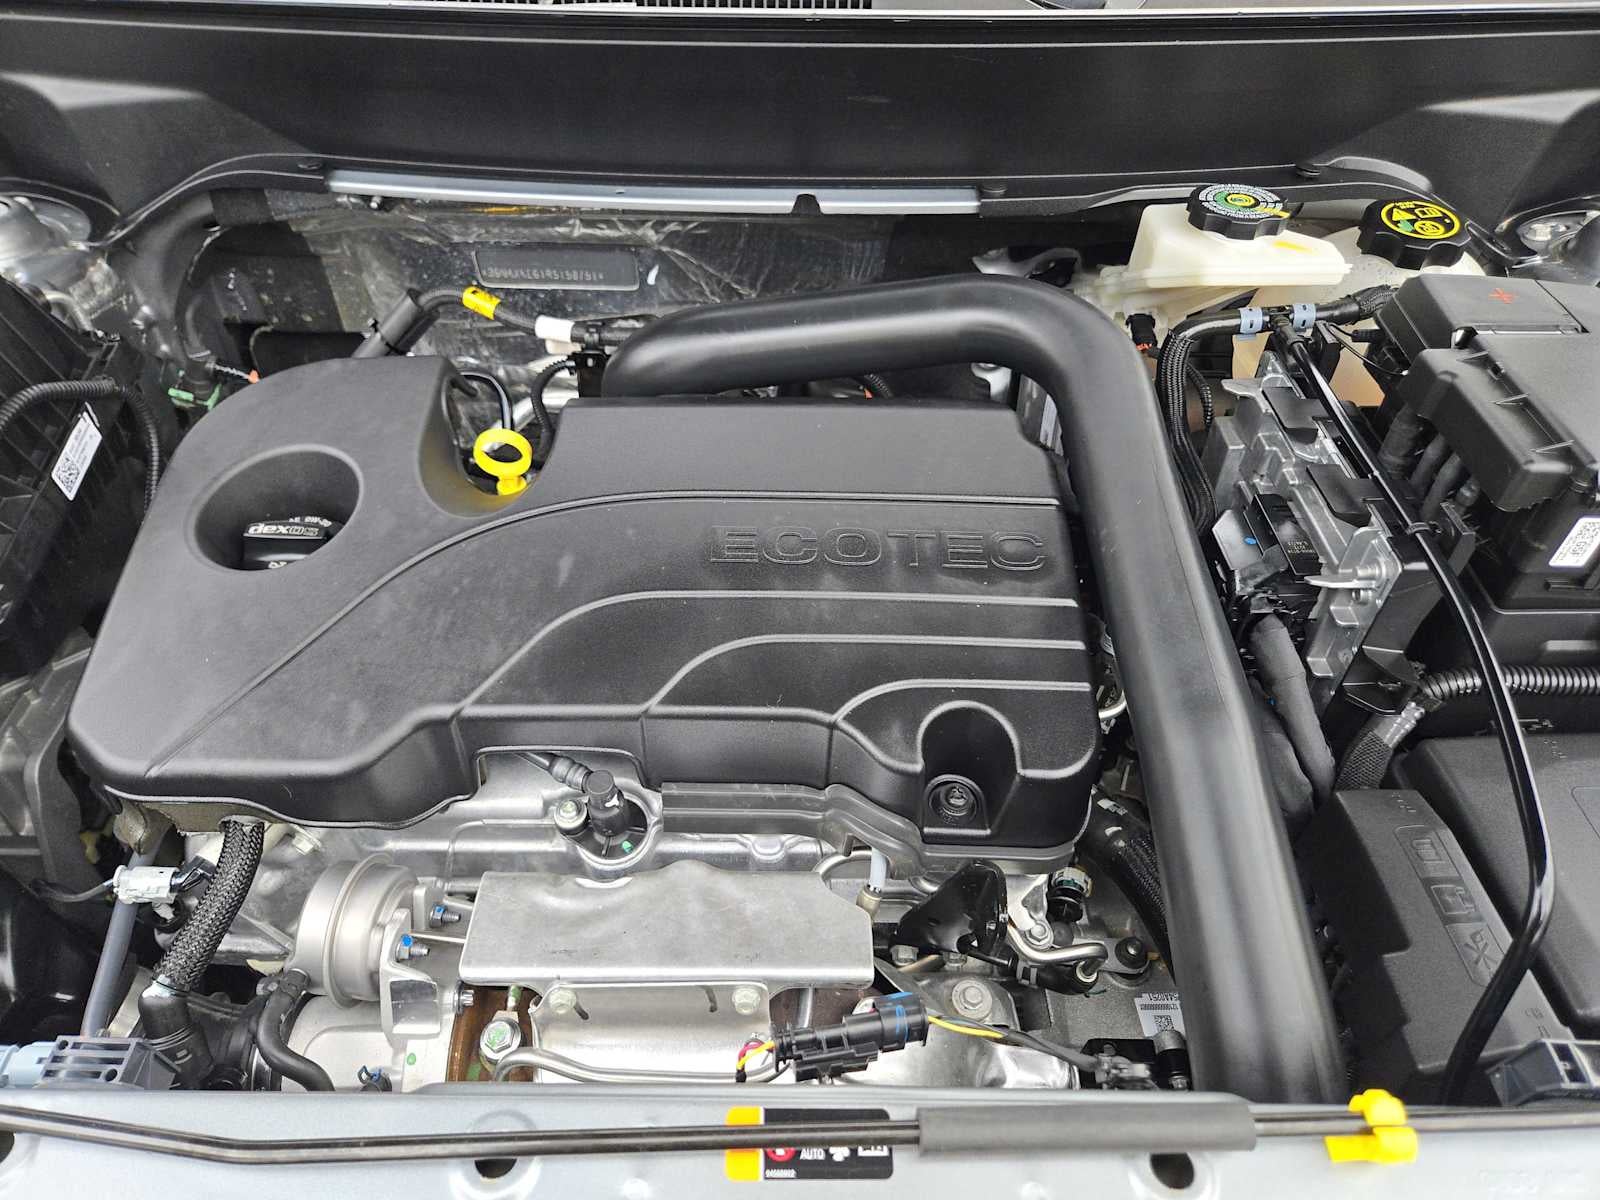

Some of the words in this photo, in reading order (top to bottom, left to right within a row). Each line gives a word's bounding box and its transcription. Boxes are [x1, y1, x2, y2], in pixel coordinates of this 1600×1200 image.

[247, 522, 321, 537] dexos
[710, 525, 1048, 571] ECOTEC
[799, 1147, 826, 1160] AUTO
